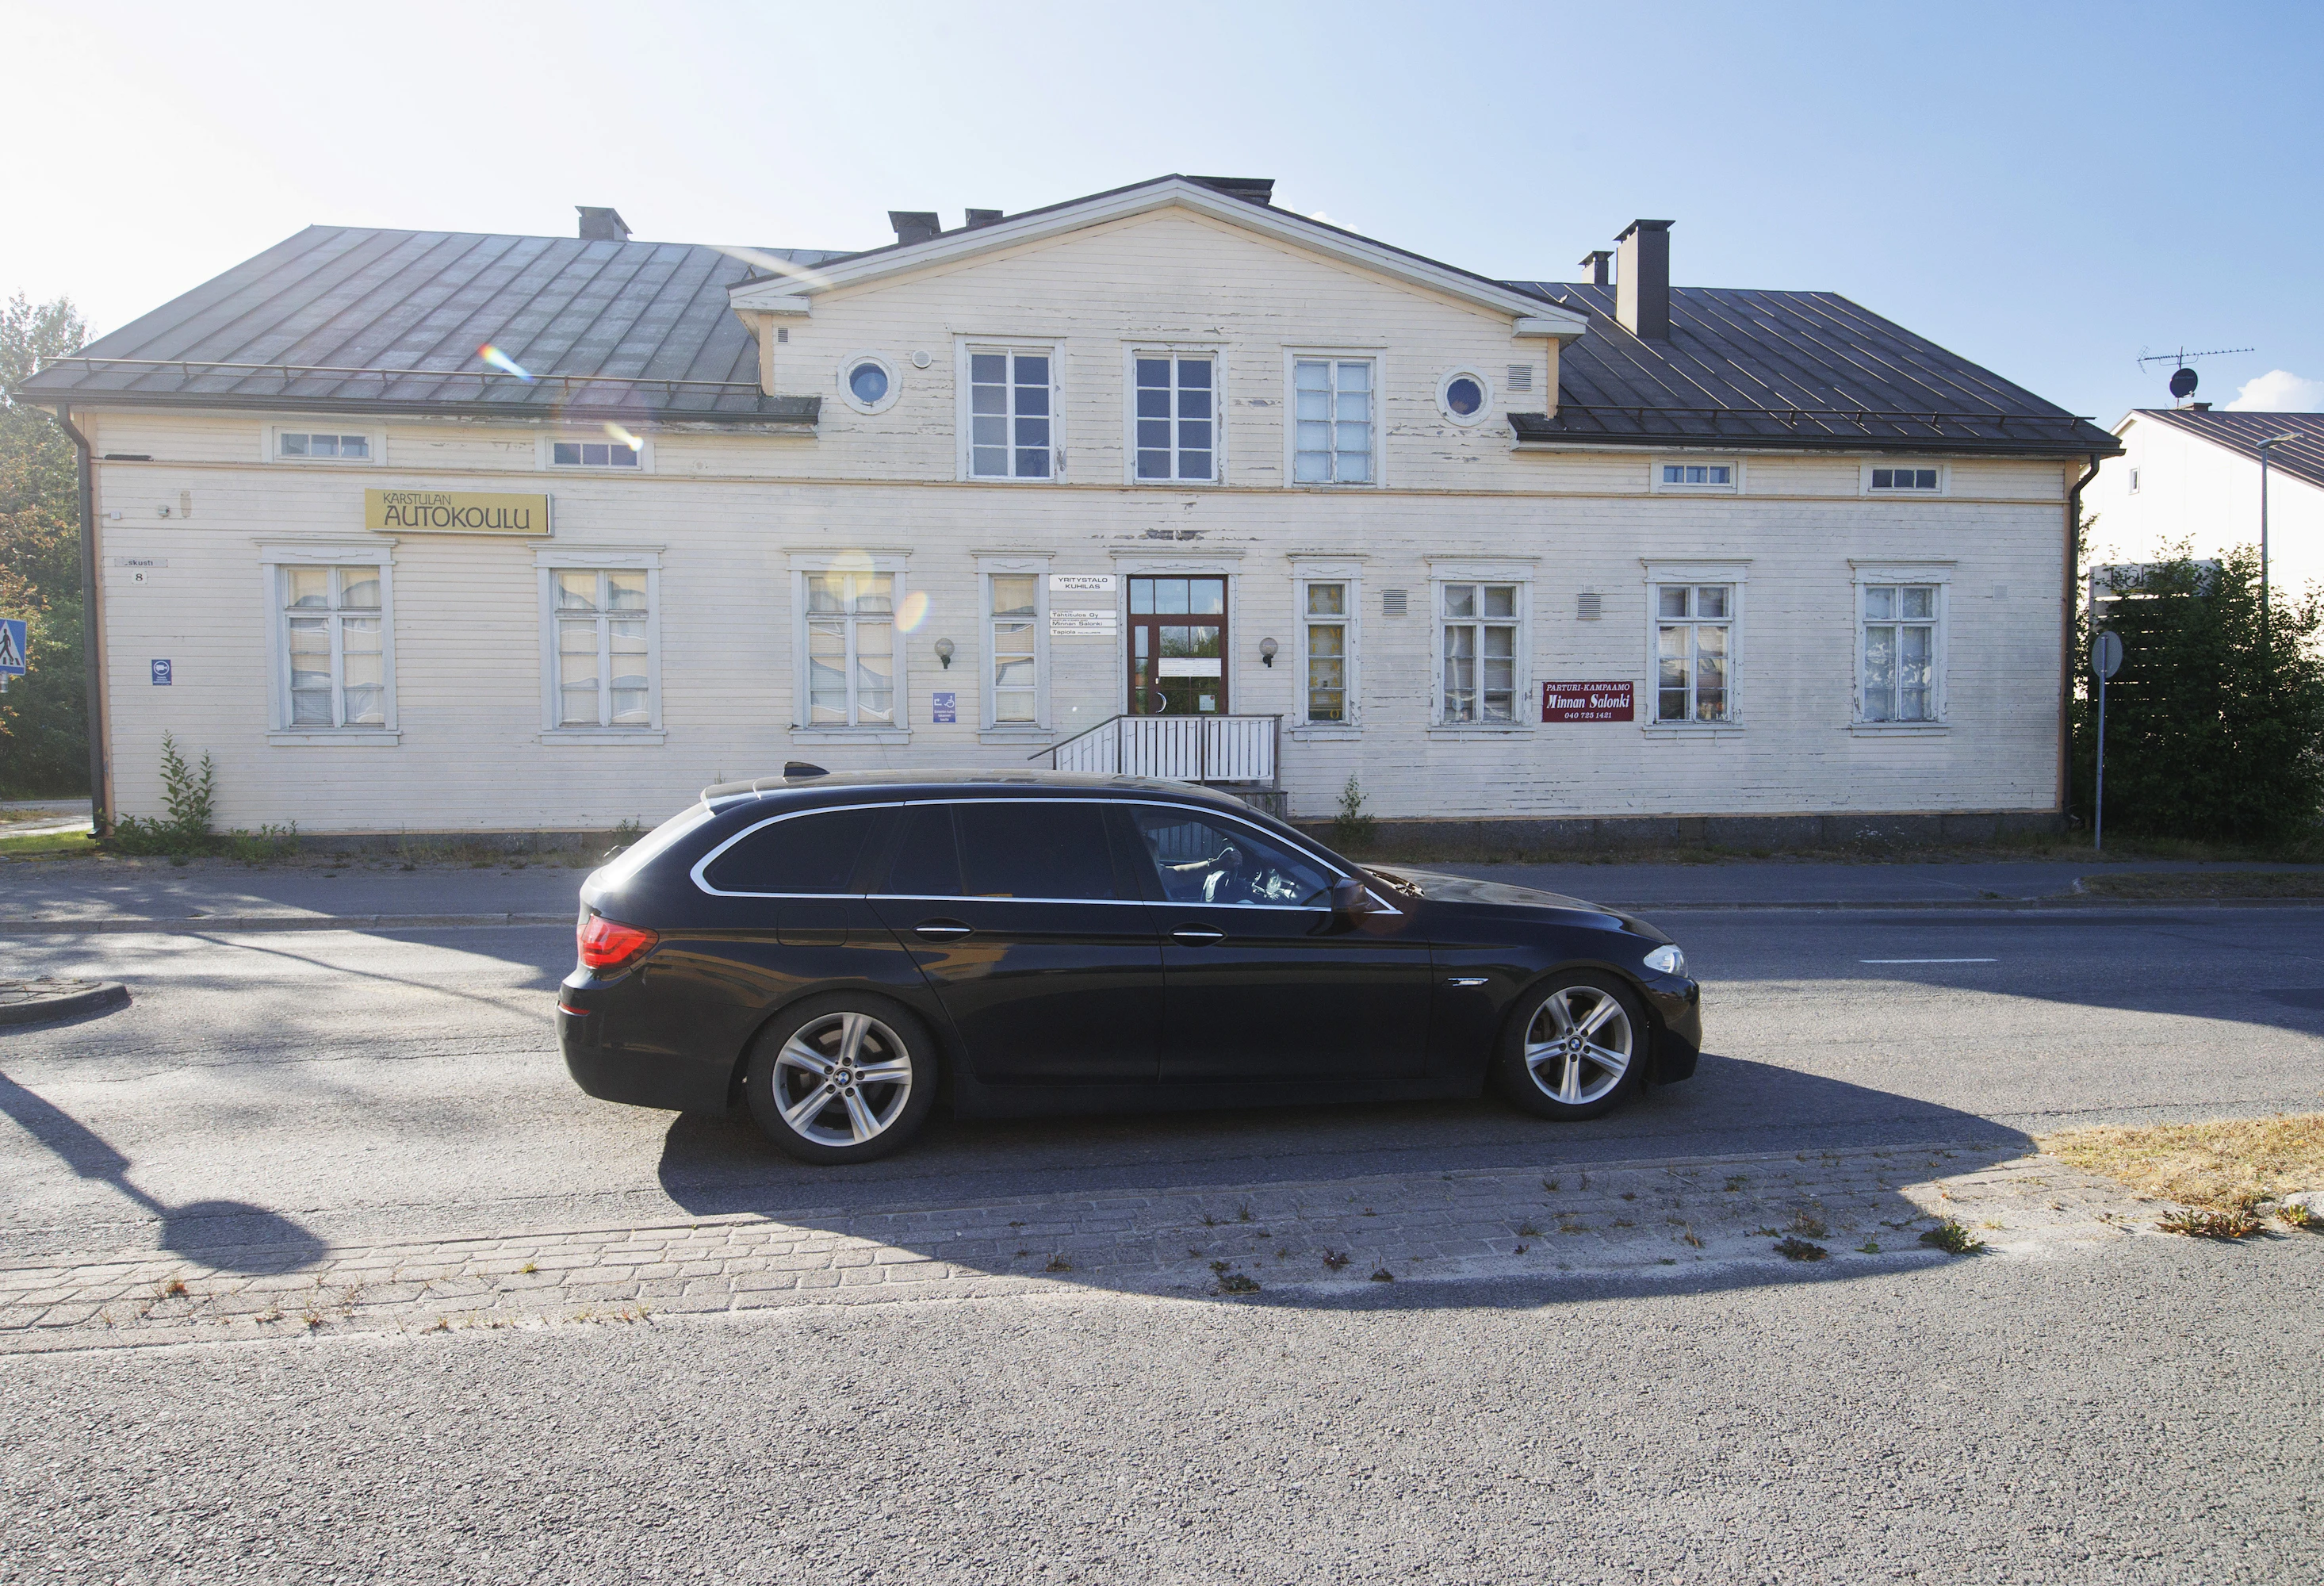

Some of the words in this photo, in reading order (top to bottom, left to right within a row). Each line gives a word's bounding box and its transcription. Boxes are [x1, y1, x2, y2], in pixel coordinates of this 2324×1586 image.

[383, 492, 451, 505] KARSTULAN
[384, 505, 530, 530] AUTOKOULU
[1546, 694, 1585, 709] Minnan
[1589, 693, 1630, 708] Salonki
